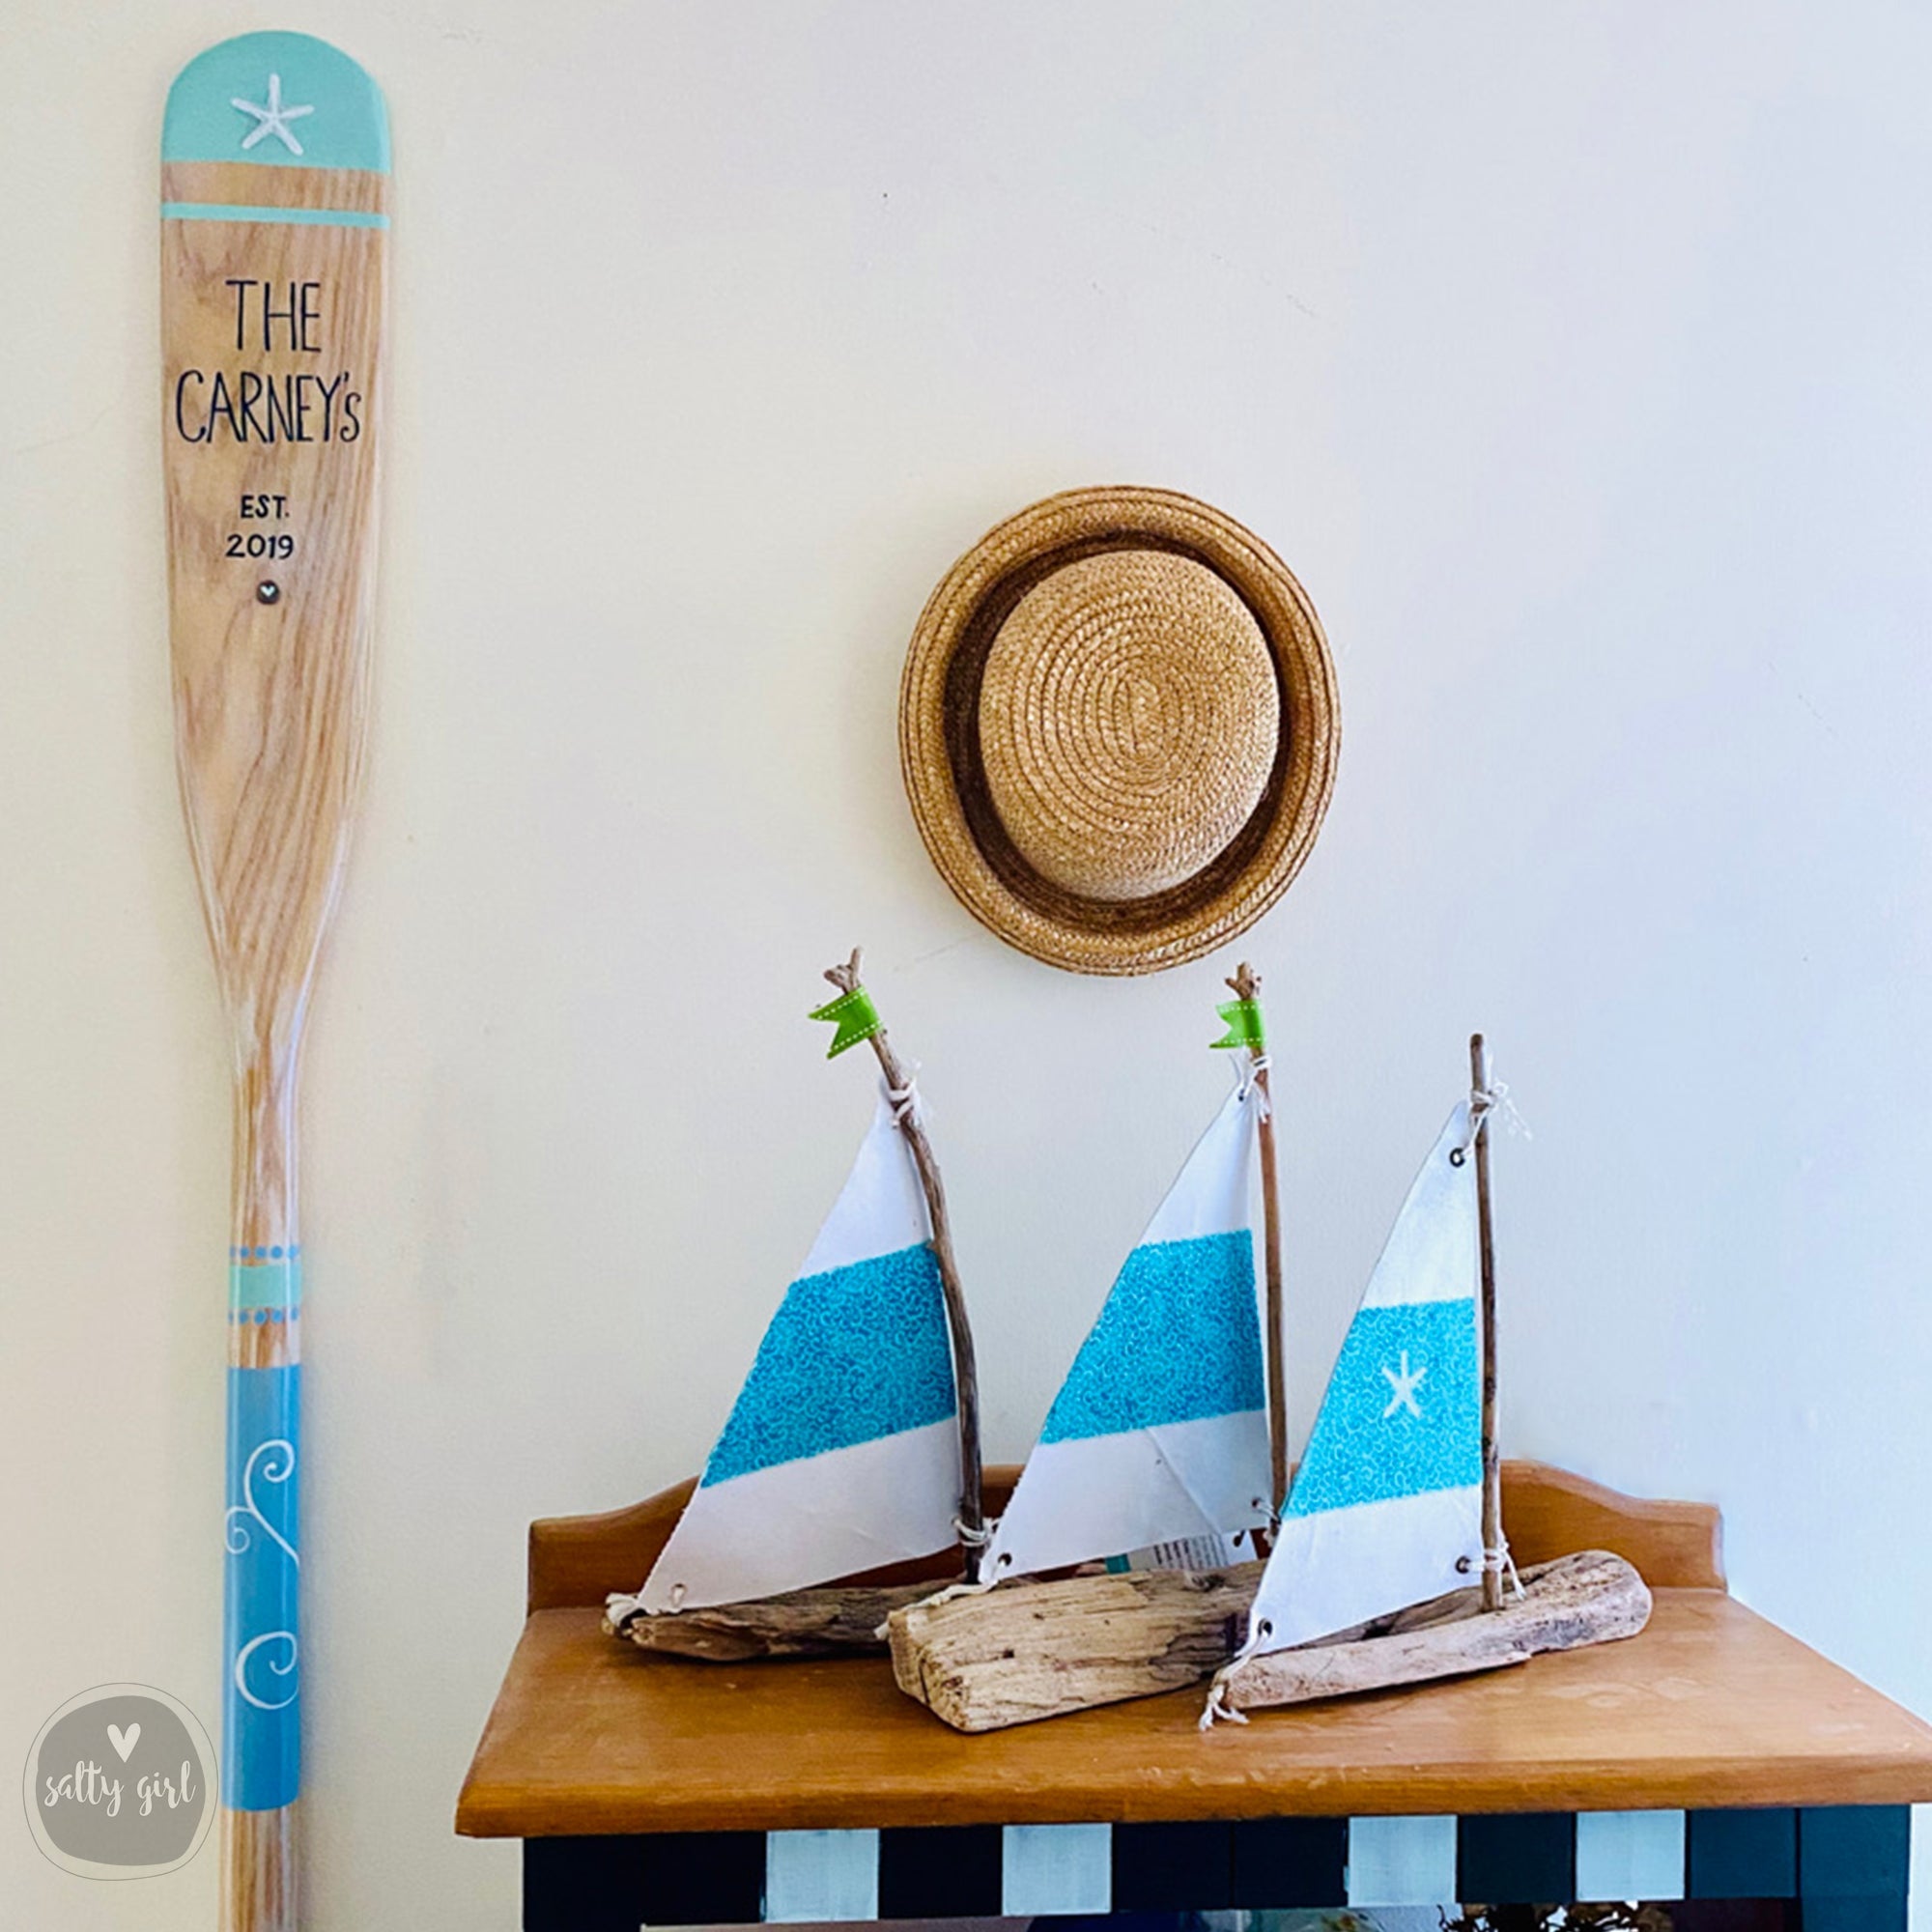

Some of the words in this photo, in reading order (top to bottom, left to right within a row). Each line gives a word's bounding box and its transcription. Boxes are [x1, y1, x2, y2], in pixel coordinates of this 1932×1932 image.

[225, 280, 321, 353] THE
[241, 495, 290, 519] EST.
[225, 534, 294, 559] 2019
